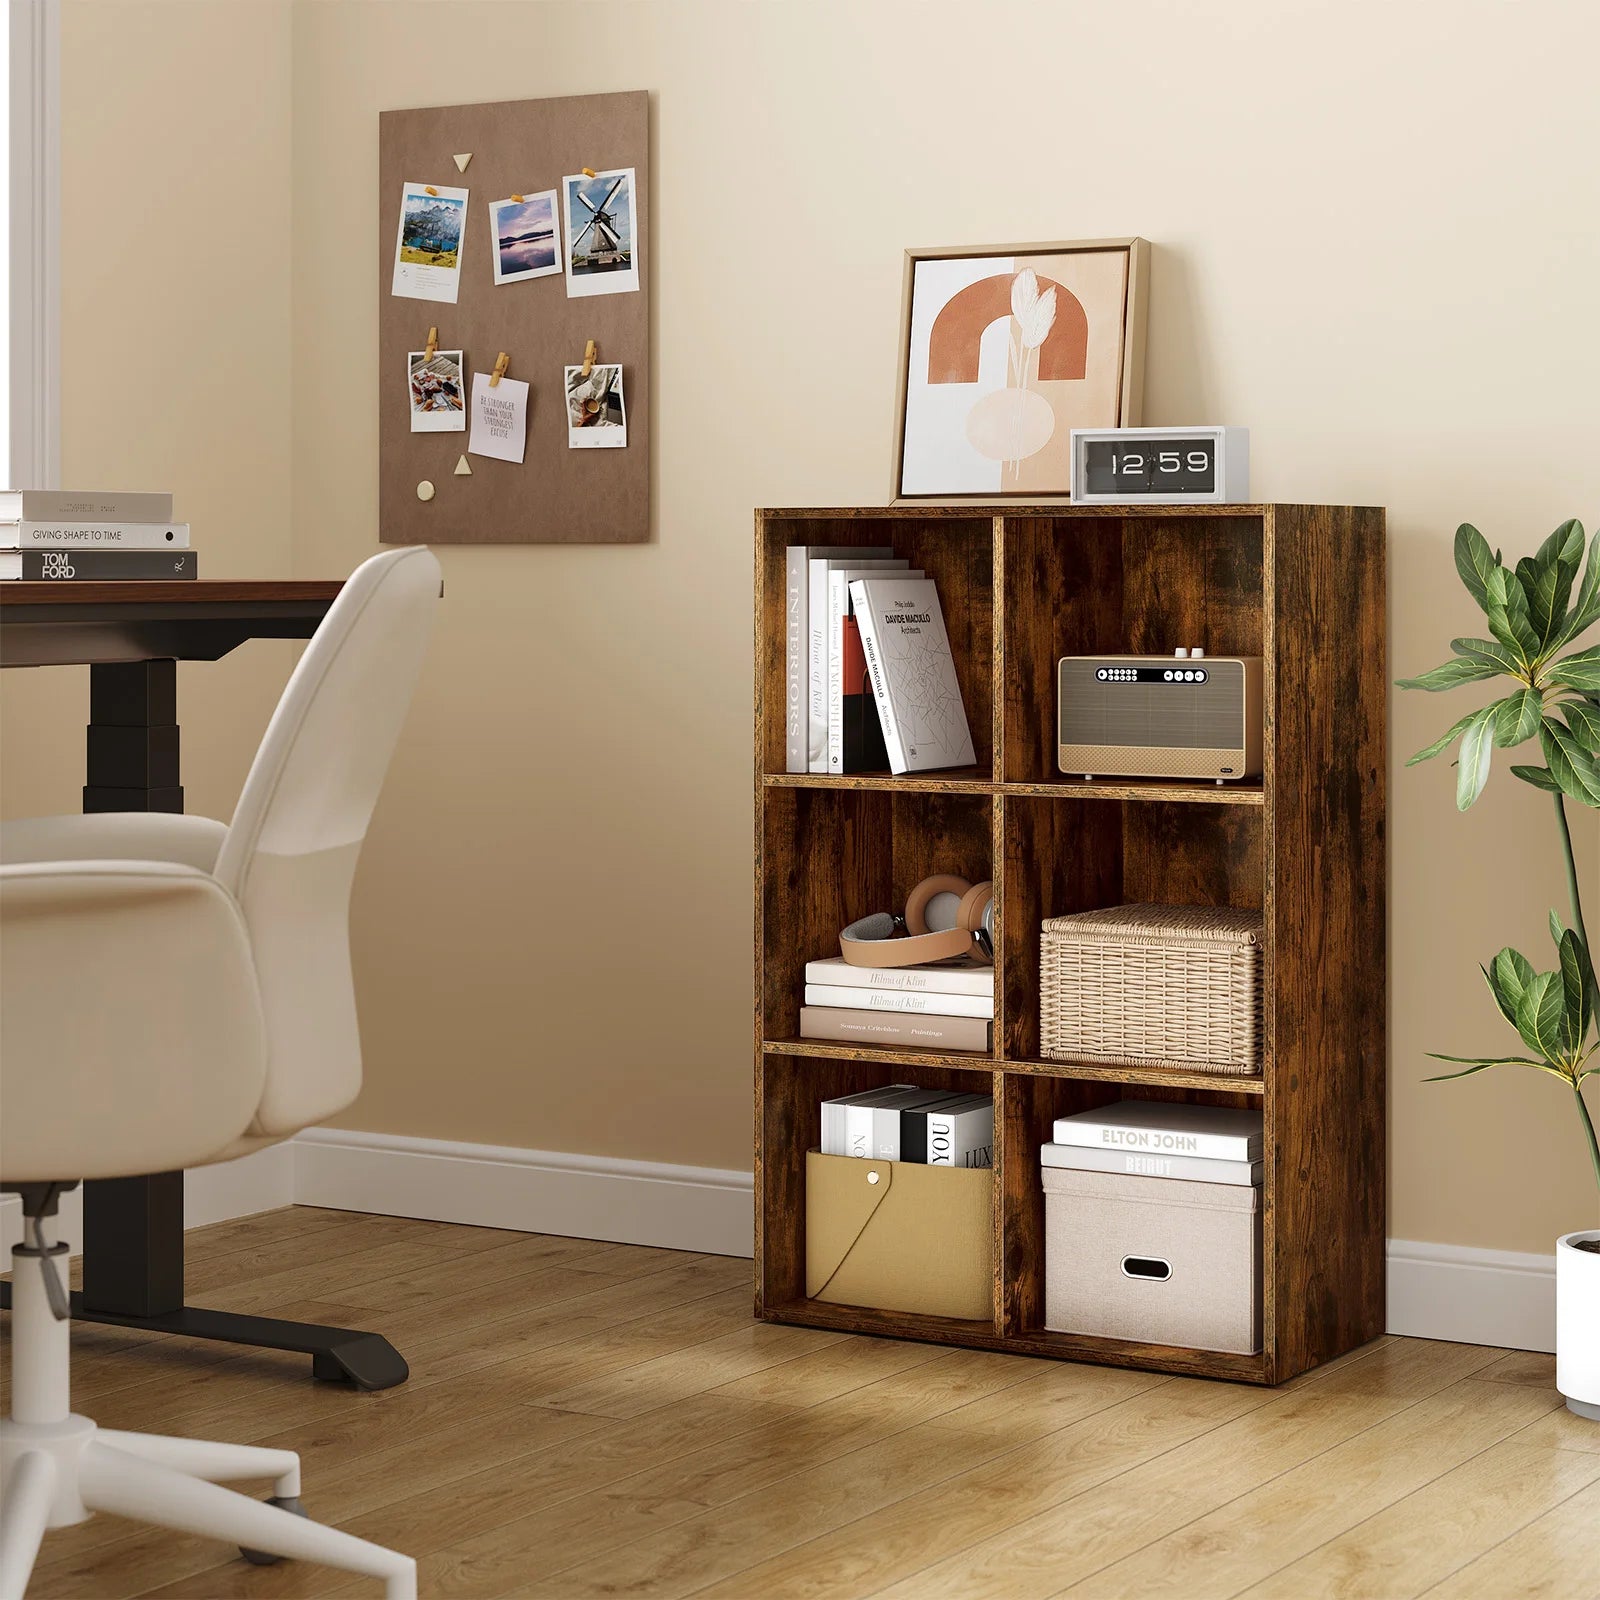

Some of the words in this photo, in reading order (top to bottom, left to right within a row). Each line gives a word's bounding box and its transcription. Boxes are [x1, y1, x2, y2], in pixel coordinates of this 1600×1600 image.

[480, 395, 487, 407] BE
[487, 397, 515, 411] STRONGER
[483, 407, 498, 418] THAN
[499, 410, 513, 420] YOUR
[484, 416, 514, 430] STRONGEST
[490, 427, 508, 439] EXCUSE
[32, 530, 62, 540] GIVING
[63, 530, 89, 540] SHAPE
[90, 531, 102, 540] TO
[103, 531, 122, 540] TIME
[42, 553, 69, 566] TOM
[42, 566, 75, 579] FORD
[885, 614, 906, 624] DAVIDE
[905, 613, 931, 624] MACULLO
[790, 587, 800, 736] INTERIORS
[865, 637, 876, 663] DAVIDE
[872, 663, 884, 698] MACULLO
[831, 652, 840, 752] ATMOSPHERE
[869, 972, 895, 985] Hilma
[894, 972, 905, 989] af
[906, 973, 927, 987] Klint
[869, 994, 895, 1007] Hilma
[894, 996, 905, 1011] af
[905, 996, 926, 1009] Klint
[840, 1022, 866, 1031] Somaya
[910, 1028, 943, 1037] Paintings
[932, 1122, 951, 1164] YOU
[1102, 1129, 1149, 1147] ELTON
[1153, 1134, 1198, 1151] JOHN
[1125, 1155, 1172, 1176] BEIRUT
